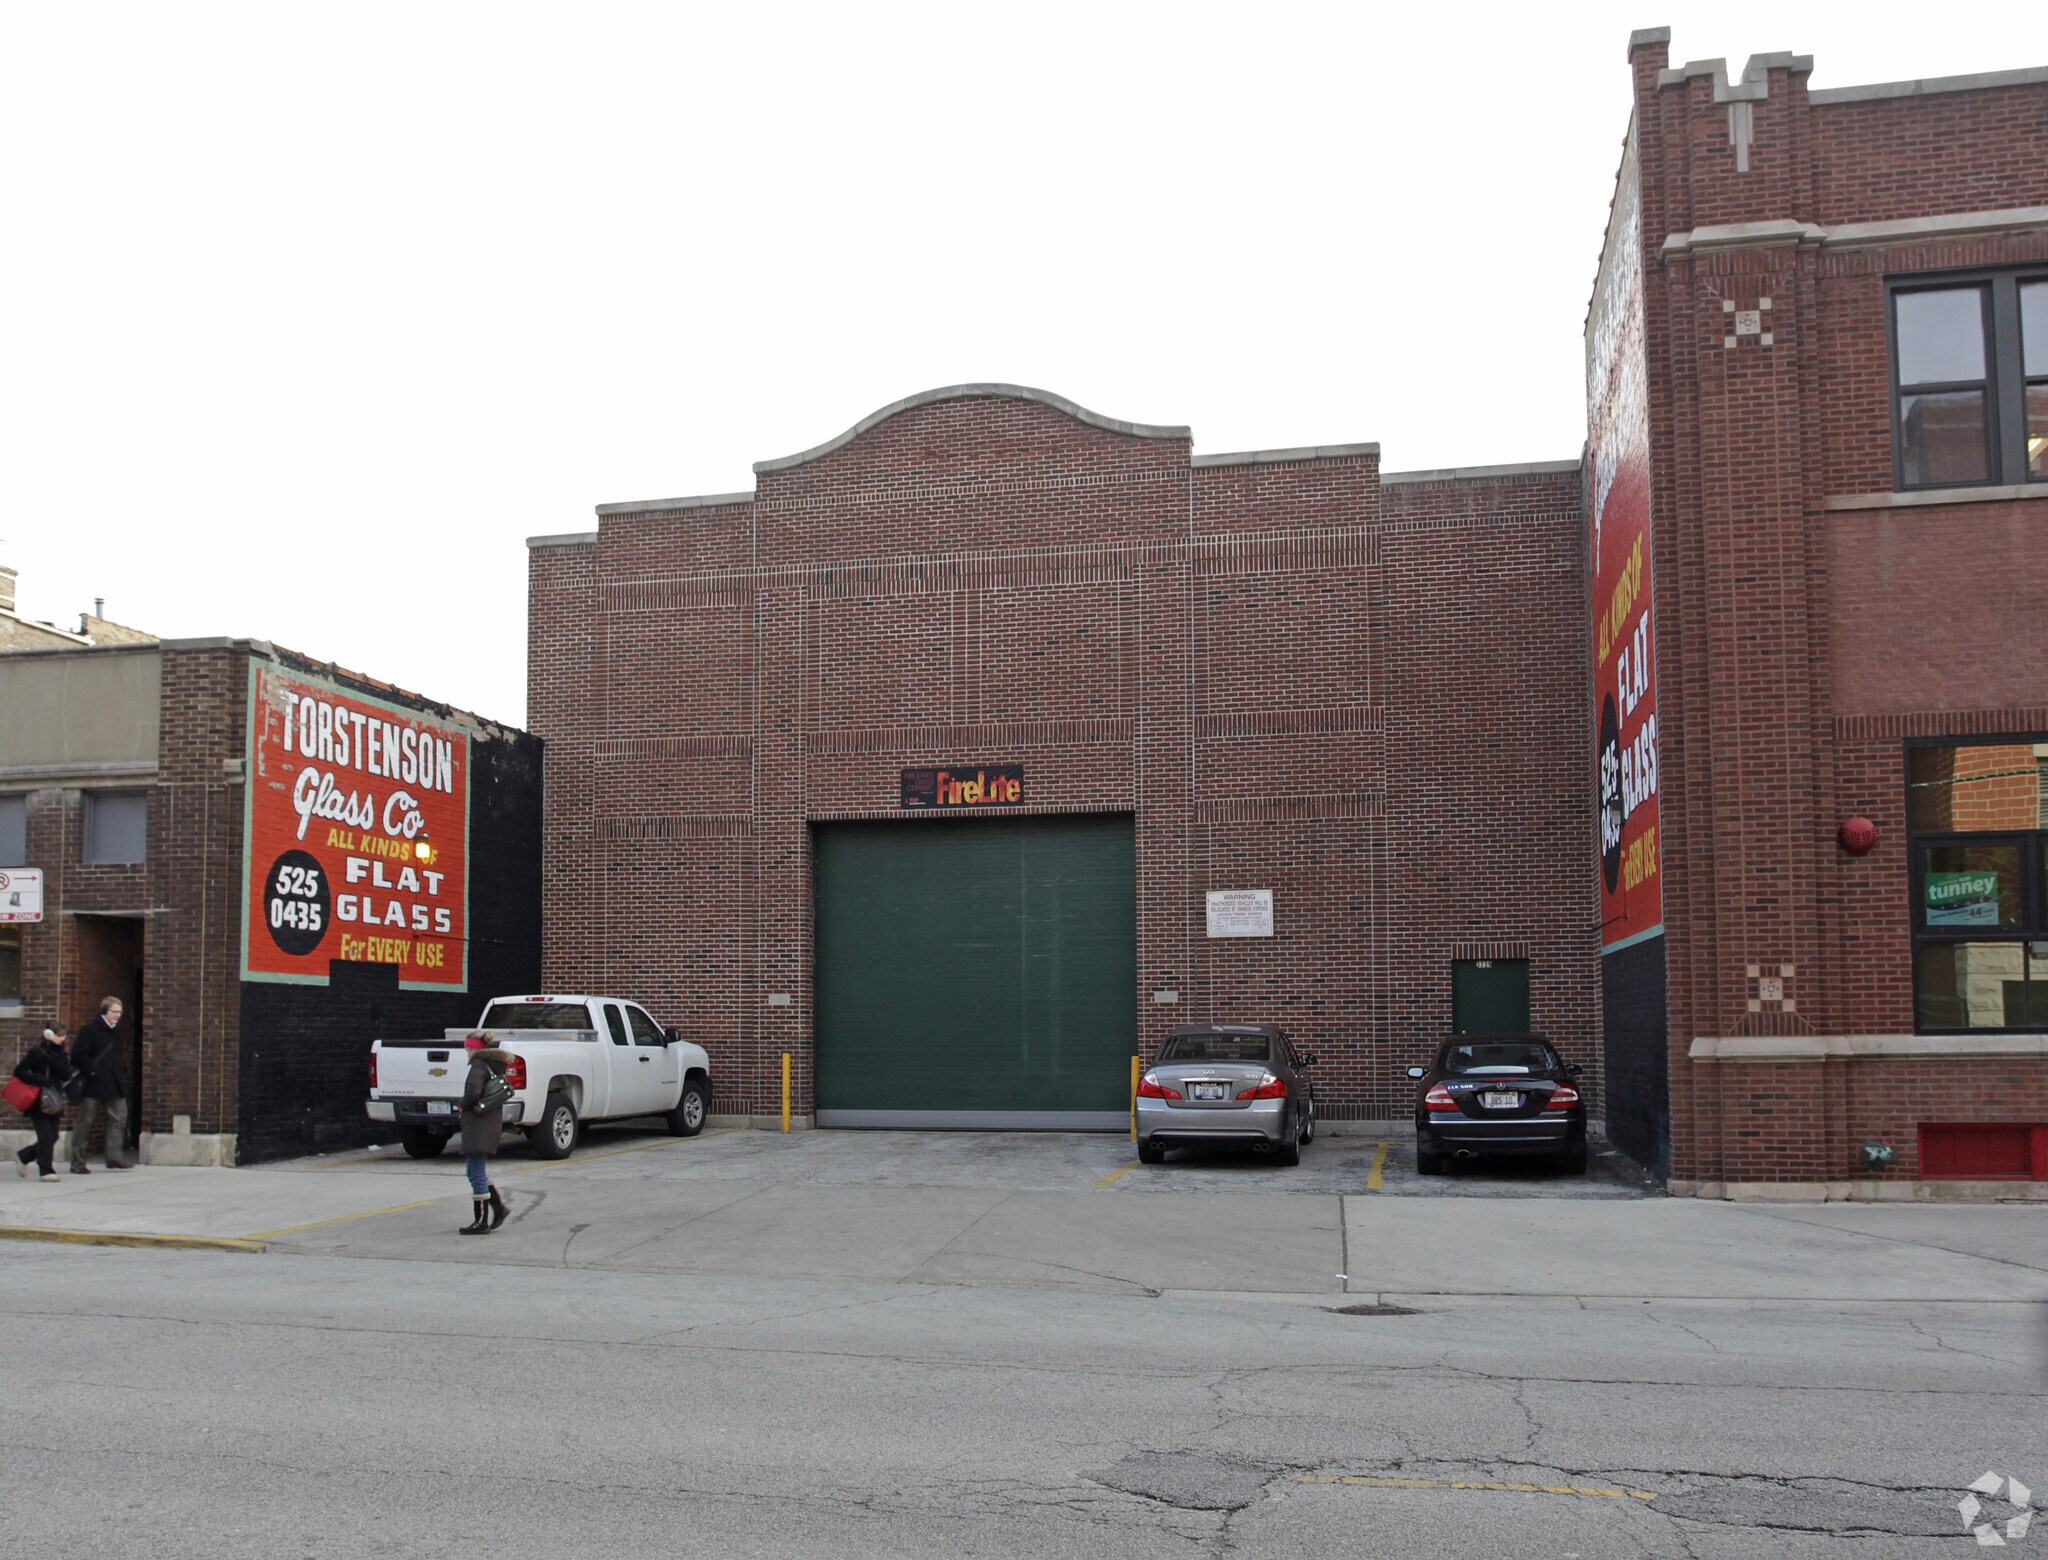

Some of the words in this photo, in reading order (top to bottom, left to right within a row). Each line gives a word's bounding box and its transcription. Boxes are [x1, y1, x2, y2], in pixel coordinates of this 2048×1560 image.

[1598, 608, 1610, 669] ALL
[1611, 556, 1631, 646] KINDS
[1631, 530, 1642, 600] OF
[1617, 608, 1649, 730] FLAT
[279, 689, 452, 794] TORSTENSON
[1601, 739, 1619, 805] 525
[1621, 713, 1657, 820] GLASS
[293, 766, 374, 841] Glass
[937, 771, 1021, 805] FireLite
[327, 828, 355, 850] ALL
[360, 834, 409, 862] KINDS
[1644, 826, 1657, 879] USE
[275, 865, 320, 898] 525
[345, 856, 445, 896] FLAT
[1929, 876, 1995, 900] tunney
[270, 898, 322, 932] 0435
[336, 893, 451, 934] GLASS
[340, 933, 366, 961] For
[367, 936, 411, 965] EVERY
[416, 941, 444, 969] USE
